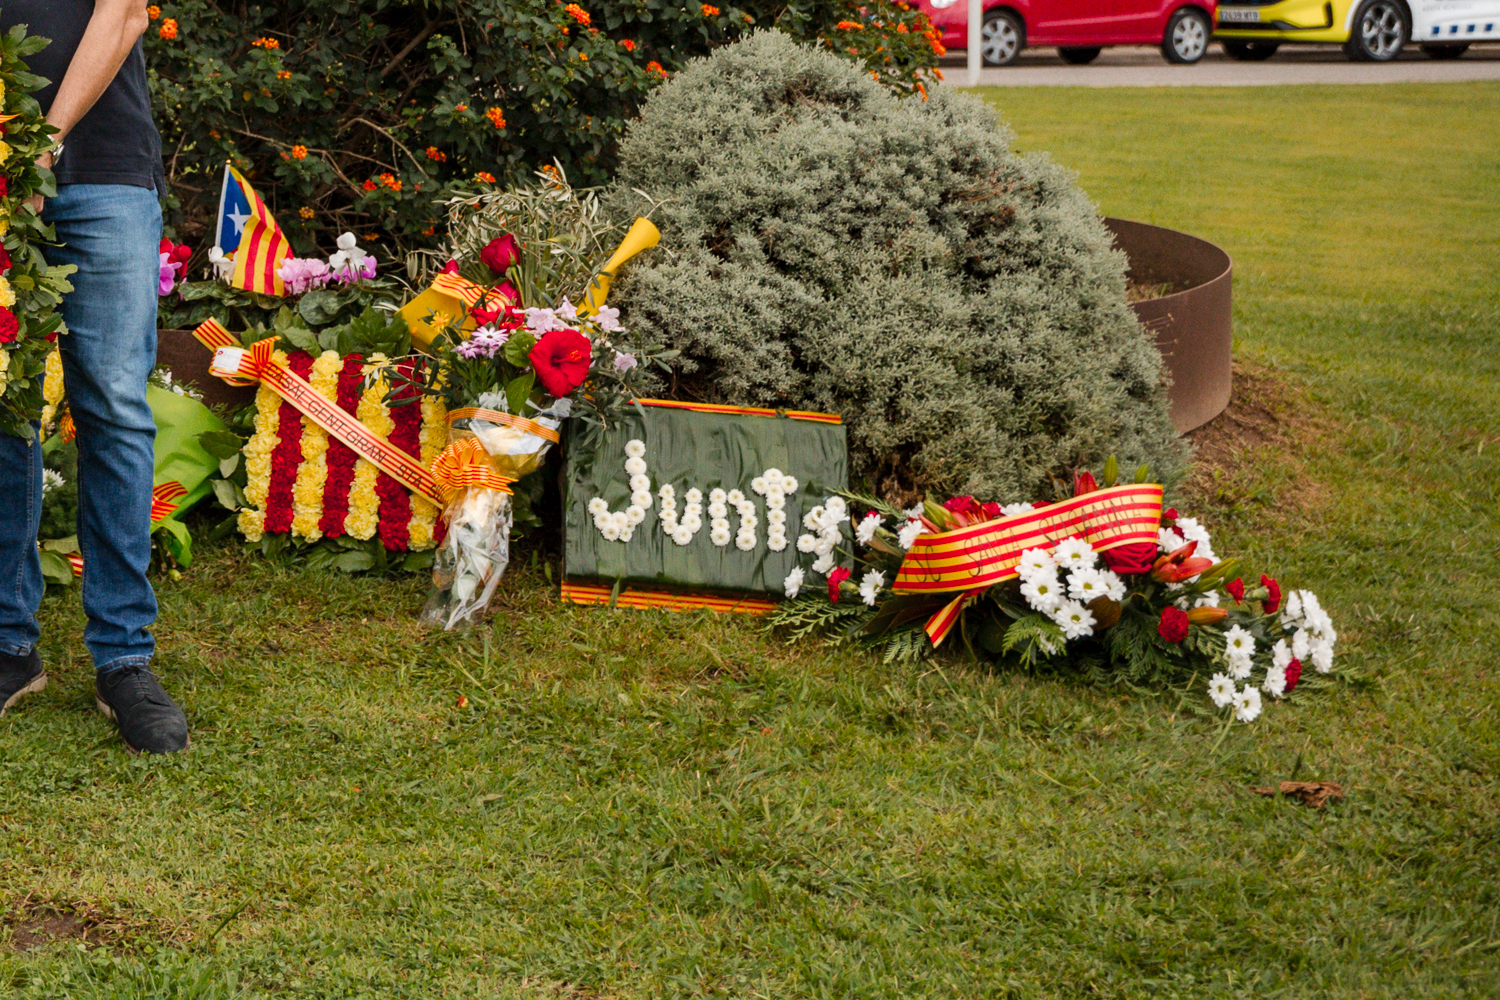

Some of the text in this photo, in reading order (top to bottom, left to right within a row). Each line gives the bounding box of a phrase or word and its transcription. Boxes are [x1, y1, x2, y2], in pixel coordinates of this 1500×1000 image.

[266, 364, 305, 405] CASAL
[307, 400, 347, 432] GENT
[346, 430, 387, 463] GRAN
[904, 544, 941, 583] PSC
[964, 528, 1020, 577] SANTA
